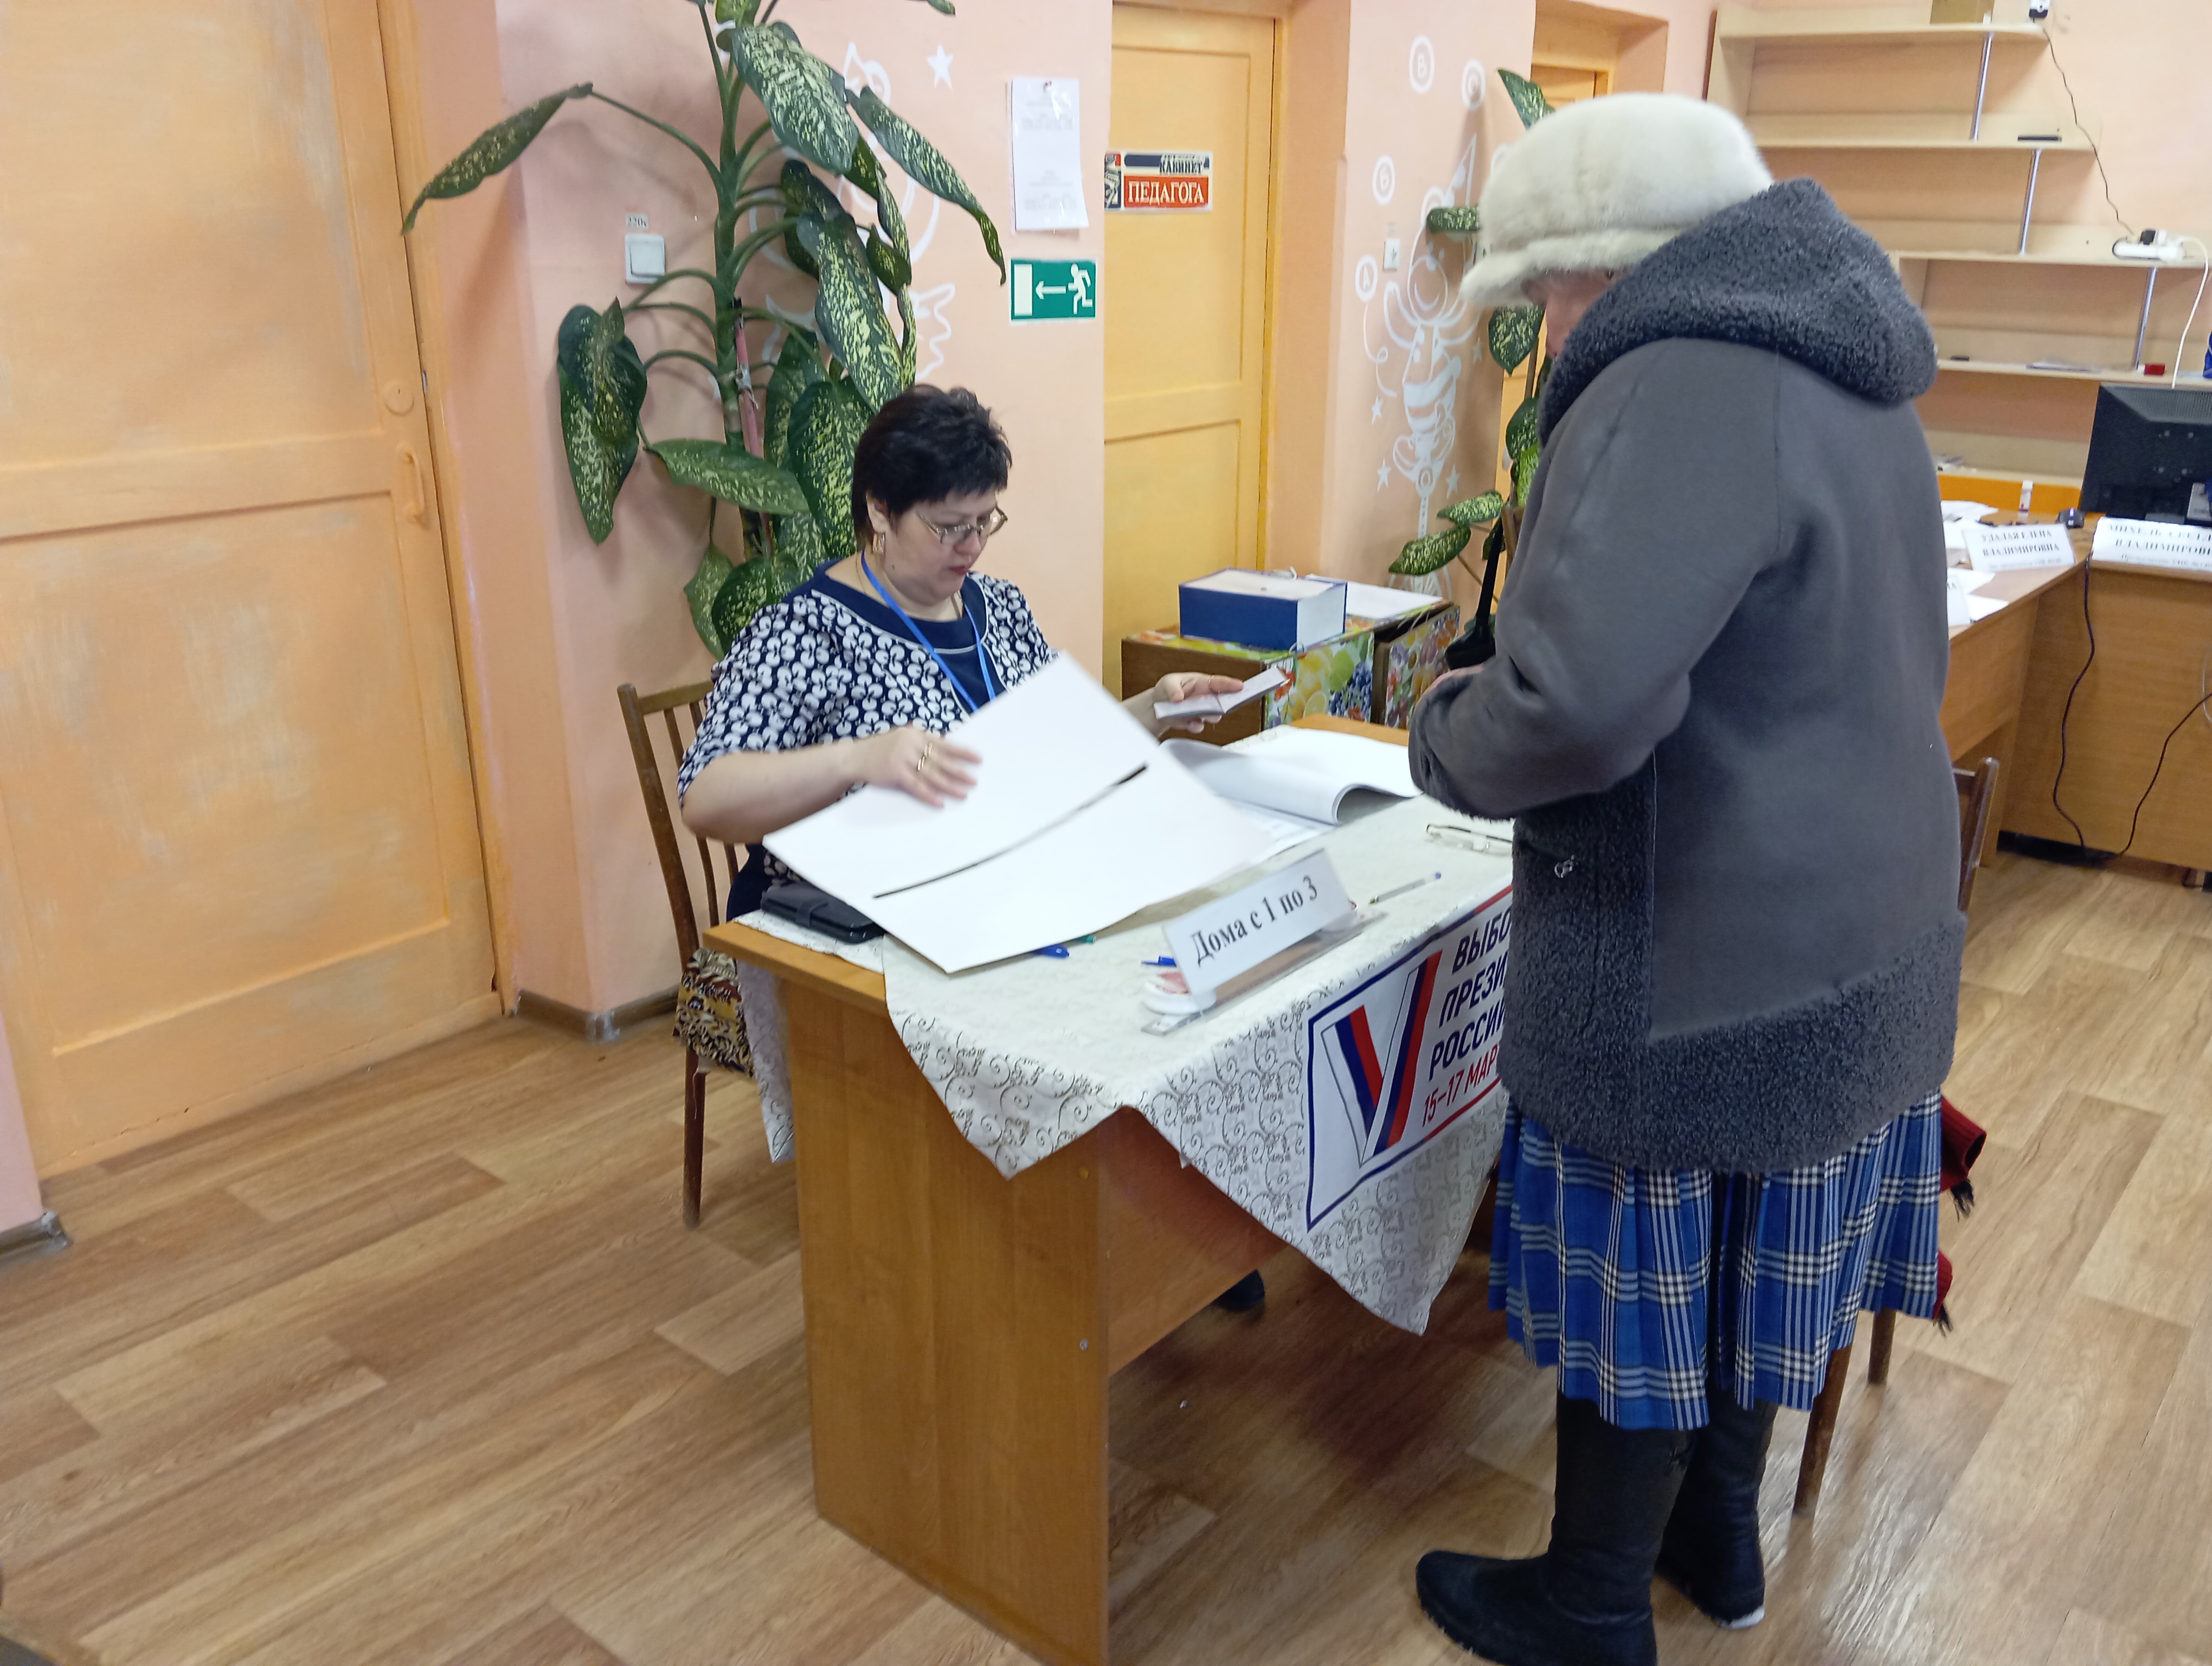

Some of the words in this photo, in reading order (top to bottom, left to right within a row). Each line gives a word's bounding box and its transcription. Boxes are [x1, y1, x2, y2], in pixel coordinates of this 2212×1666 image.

[1128, 181, 1205, 206] ПЕДАГОГА
[1982, 543, 2060, 556] ВЛАДИМИРОВНА
[1191, 918, 1249, 968] Дома
[1250, 910, 1263, 931] с
[1261, 896, 1276, 922] 1
[1279, 889, 1304, 915] по
[1303, 874, 1318, 902] 3
[1452, 906, 1512, 975] ВЫБО
[1438, 950, 1508, 1028] ПРЕЗИ
[1464, 1043, 1499, 1094] МАР
